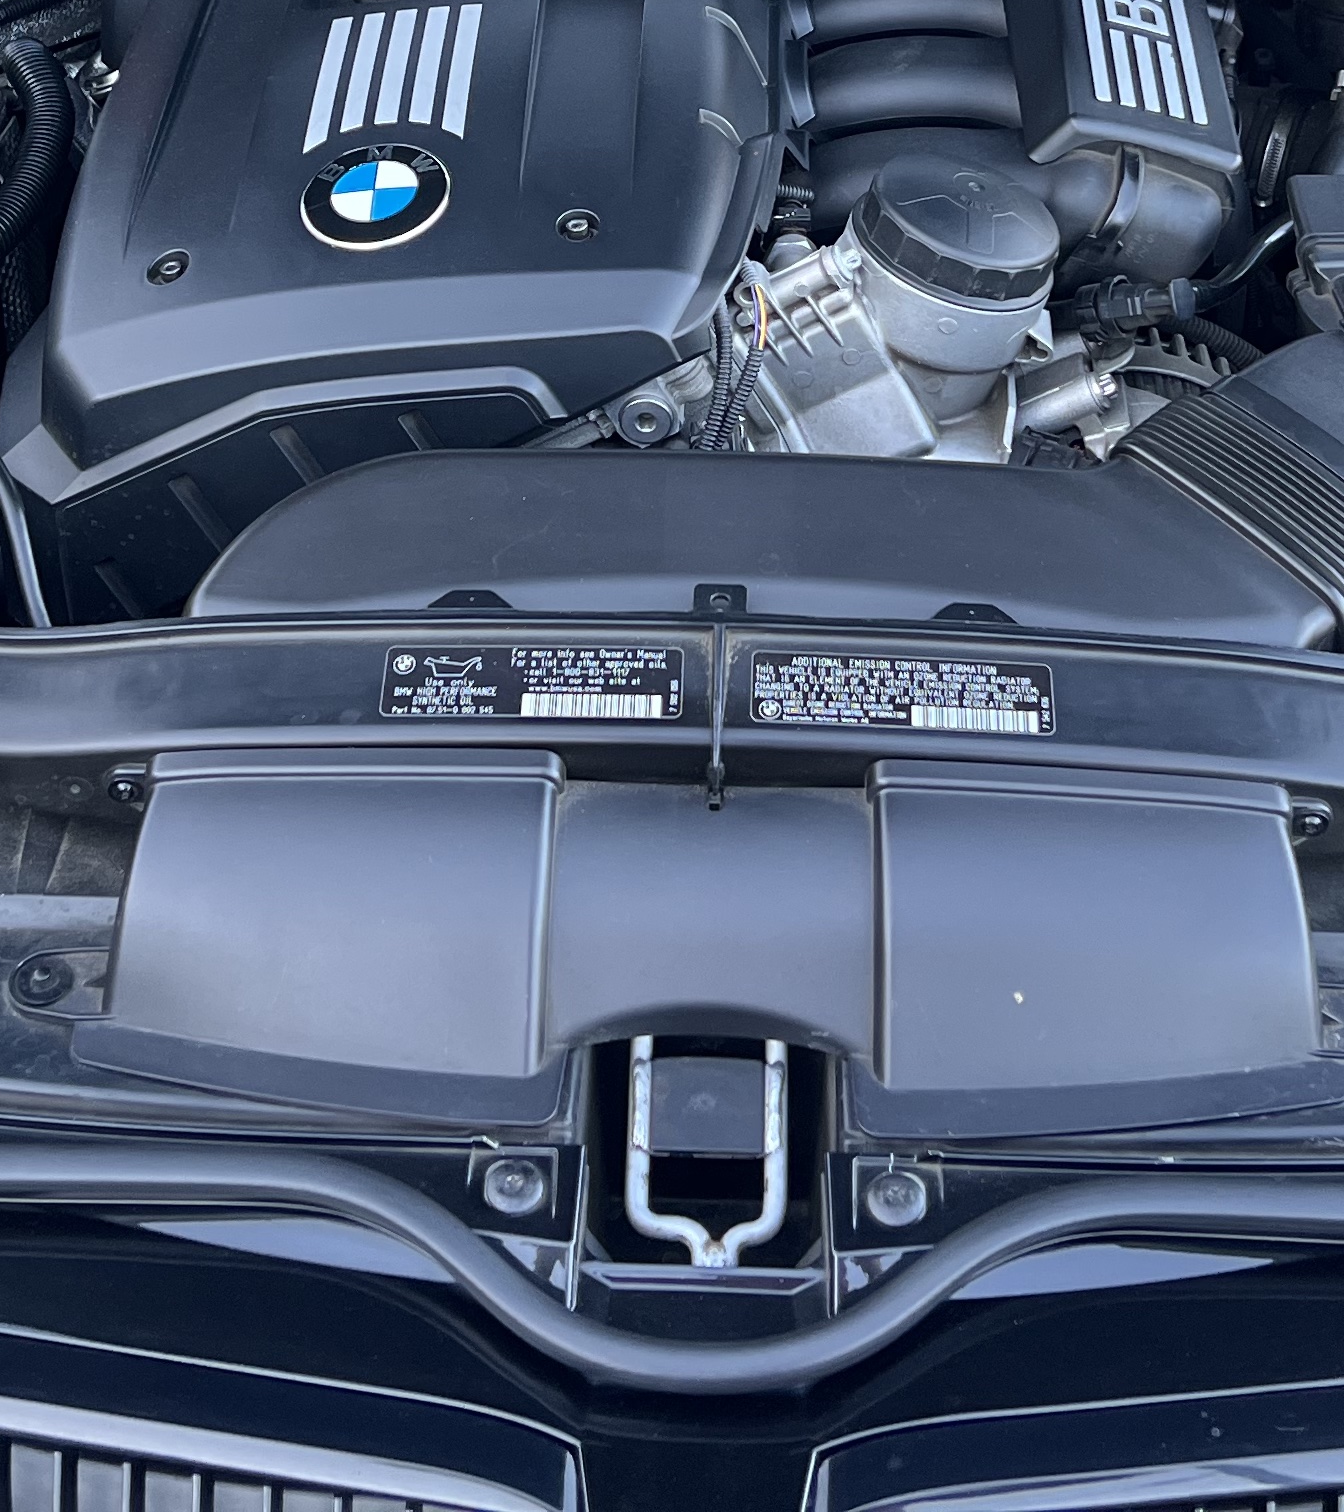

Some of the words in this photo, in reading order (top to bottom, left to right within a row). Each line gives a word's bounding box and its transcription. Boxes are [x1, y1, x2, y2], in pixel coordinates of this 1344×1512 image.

[317, 145, 439, 182] BMW
[791, 656, 844, 668] ADDITIONAL
[849, 658, 891, 670] EMISSION
[895, 661, 933, 672] CONTROL
[939, 663, 997, 675] INFORMATION
[425, 677, 444, 686] Use
[451, 677, 475, 688] only
[394, 687, 413, 696] BMW
[417, 687, 436, 696] HIGH
[440, 686, 497, 696] PERFORMANCE
[412, 696, 456, 705] SYNTHETIC
[460, 697, 473, 705] OIL
